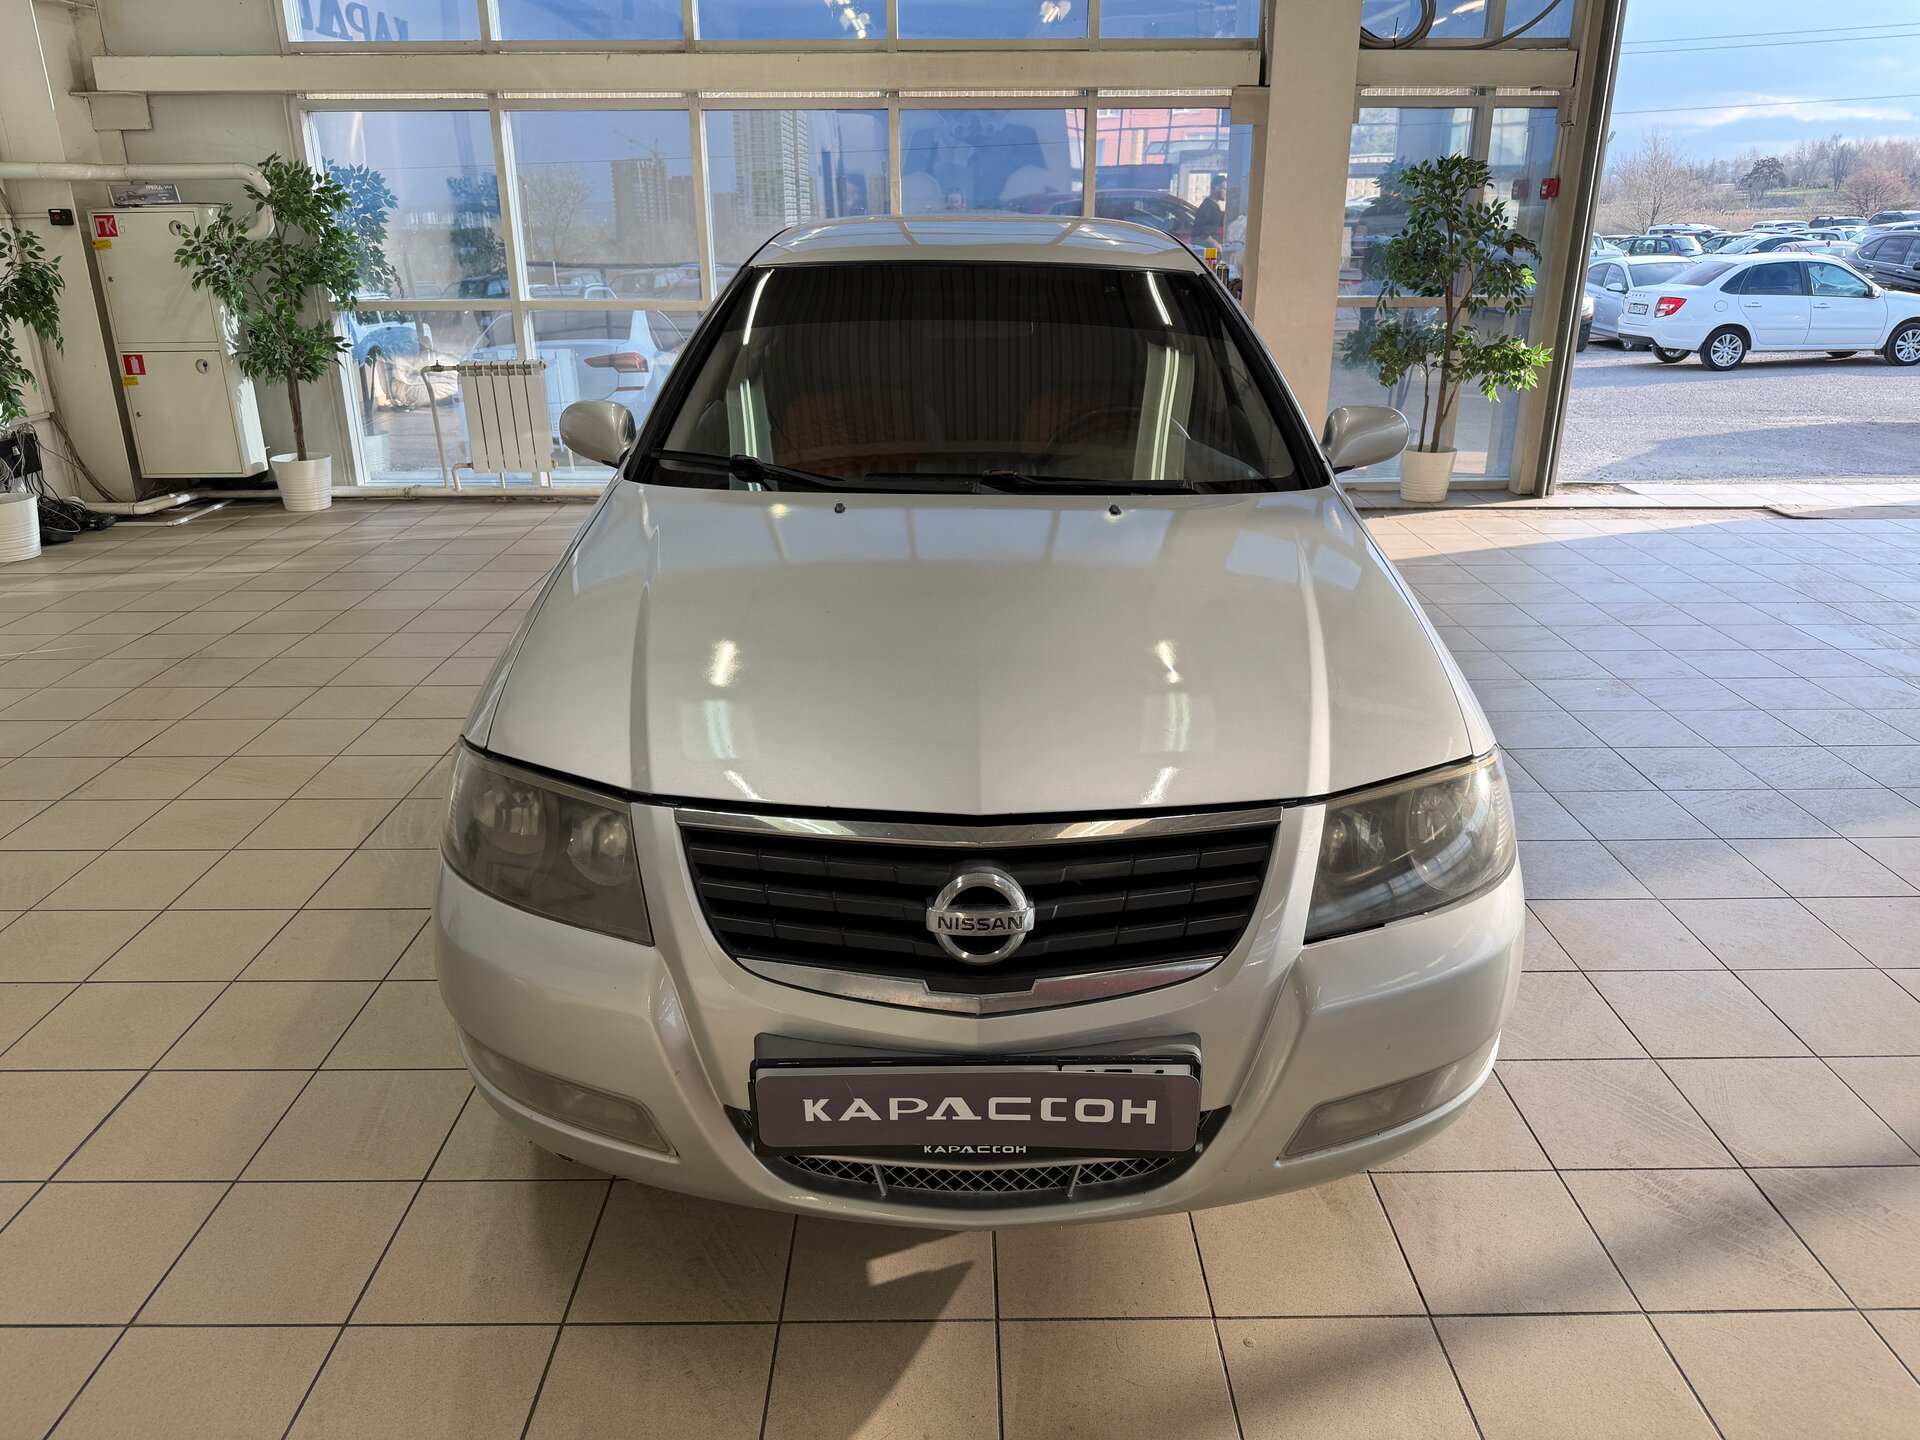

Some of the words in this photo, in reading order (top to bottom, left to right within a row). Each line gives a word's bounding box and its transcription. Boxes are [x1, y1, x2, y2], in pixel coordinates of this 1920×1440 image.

[95, 217, 117, 235] ПК
[937, 915, 1024, 932] NISSAN
[803, 1096, 1156, 1124] КАРАССОН
[924, 1144, 1027, 1154] КАРАССОН
